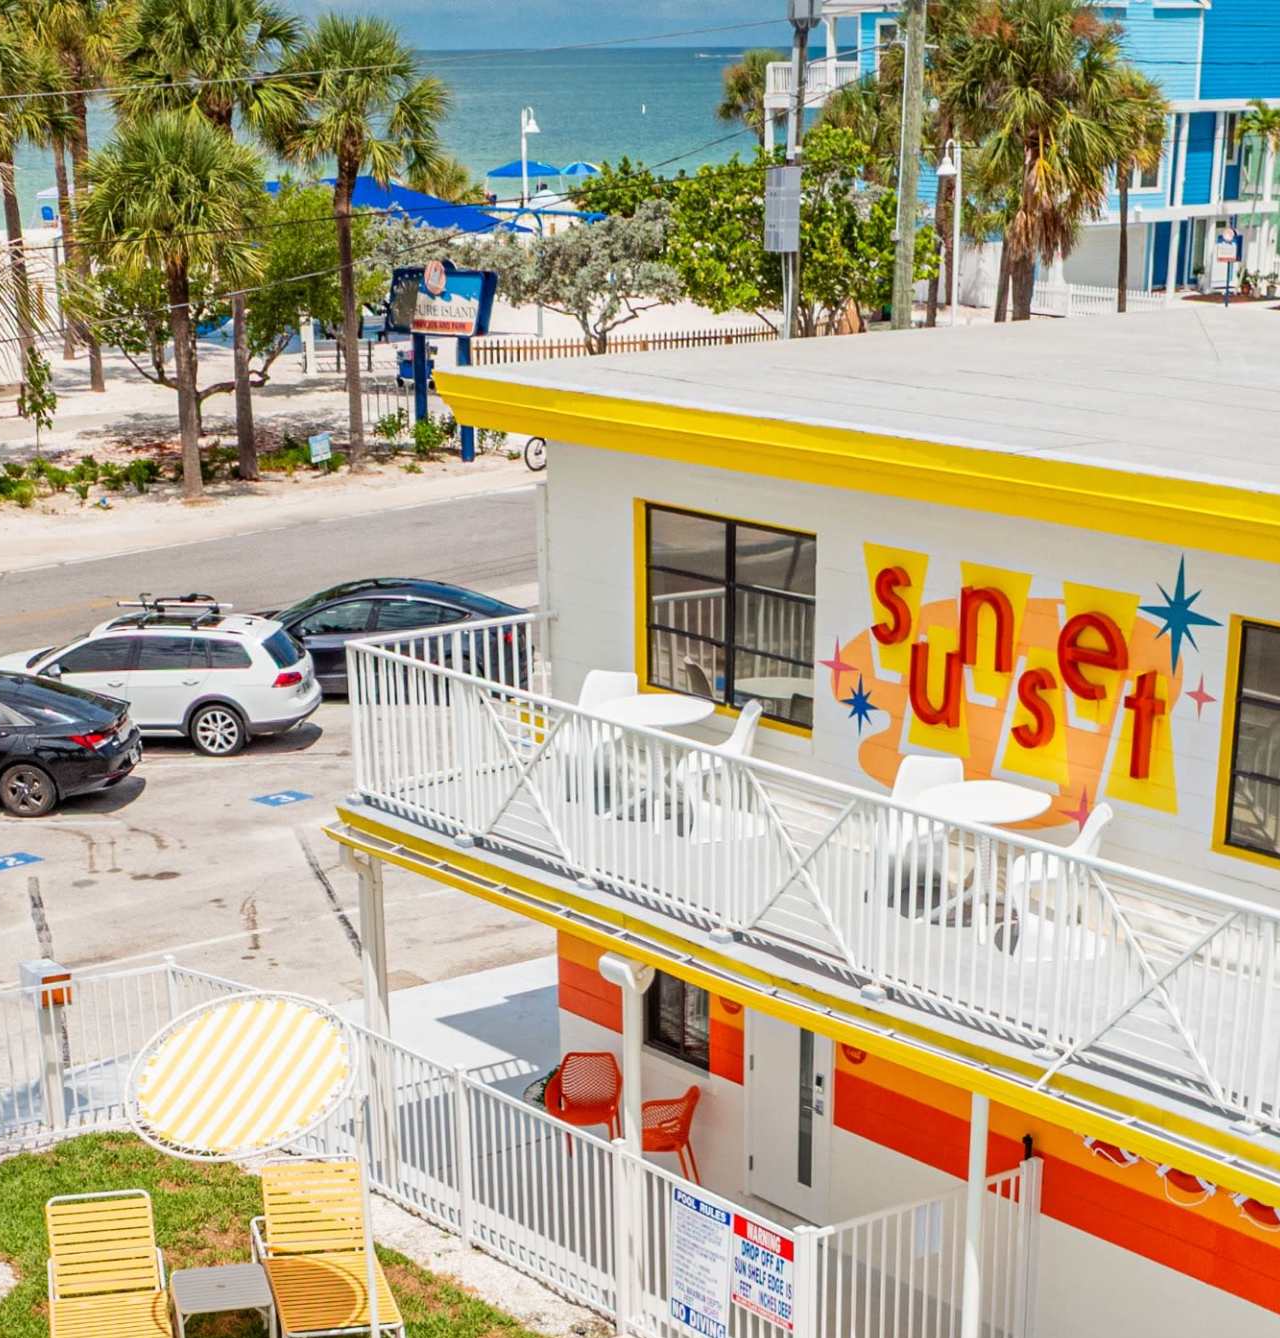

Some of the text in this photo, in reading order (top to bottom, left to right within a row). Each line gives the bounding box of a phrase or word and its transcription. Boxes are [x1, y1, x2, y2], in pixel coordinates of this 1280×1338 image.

[871, 566, 1166, 780] sunset
[677, 1188, 726, 1224] POOL RULES
[746, 1219, 781, 1254] WARNING
[741, 1240, 785, 1275] DROP OFF AT
[734, 1256, 792, 1300] SUN SHELF EDGE IS
[672, 1299, 686, 1321] NO
[778, 1299, 792, 1319] DEEP
